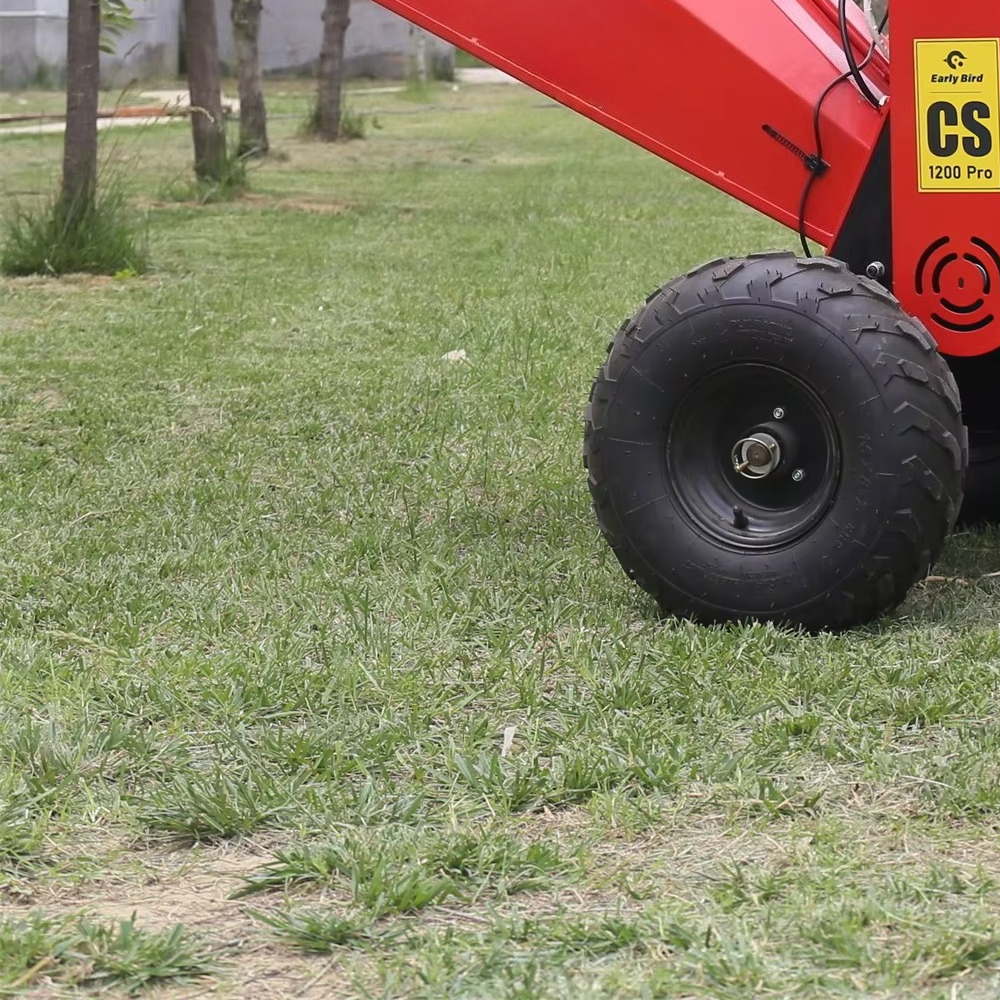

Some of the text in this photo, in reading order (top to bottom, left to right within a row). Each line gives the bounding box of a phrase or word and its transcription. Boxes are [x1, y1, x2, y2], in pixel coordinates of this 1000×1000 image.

[930, 73, 984, 84] Early Bird
[926, 101, 993, 158] CS
[928, 165, 993, 179] 1200 Pro
